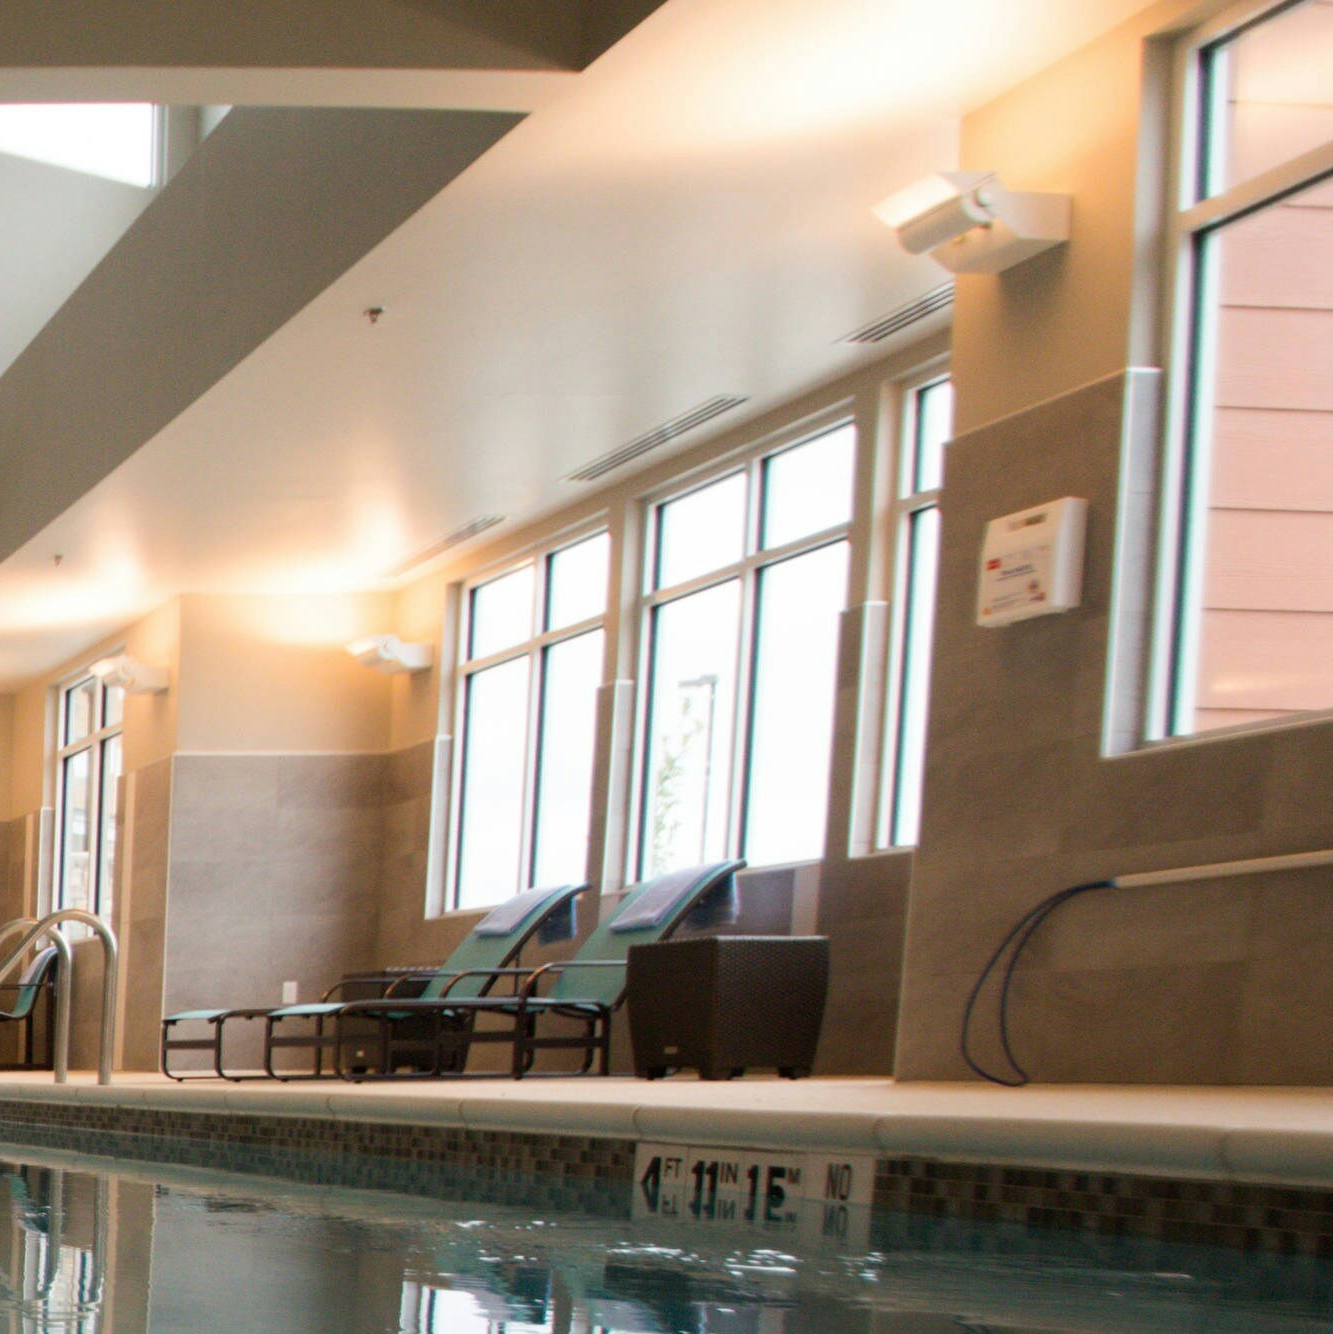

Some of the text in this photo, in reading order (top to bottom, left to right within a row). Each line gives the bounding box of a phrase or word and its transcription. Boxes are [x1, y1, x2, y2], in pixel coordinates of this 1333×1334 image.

[664, 1158, 682, 1178] FT
[720, 1162, 738, 1183] IN
[826, 1163, 852, 1200] NO
